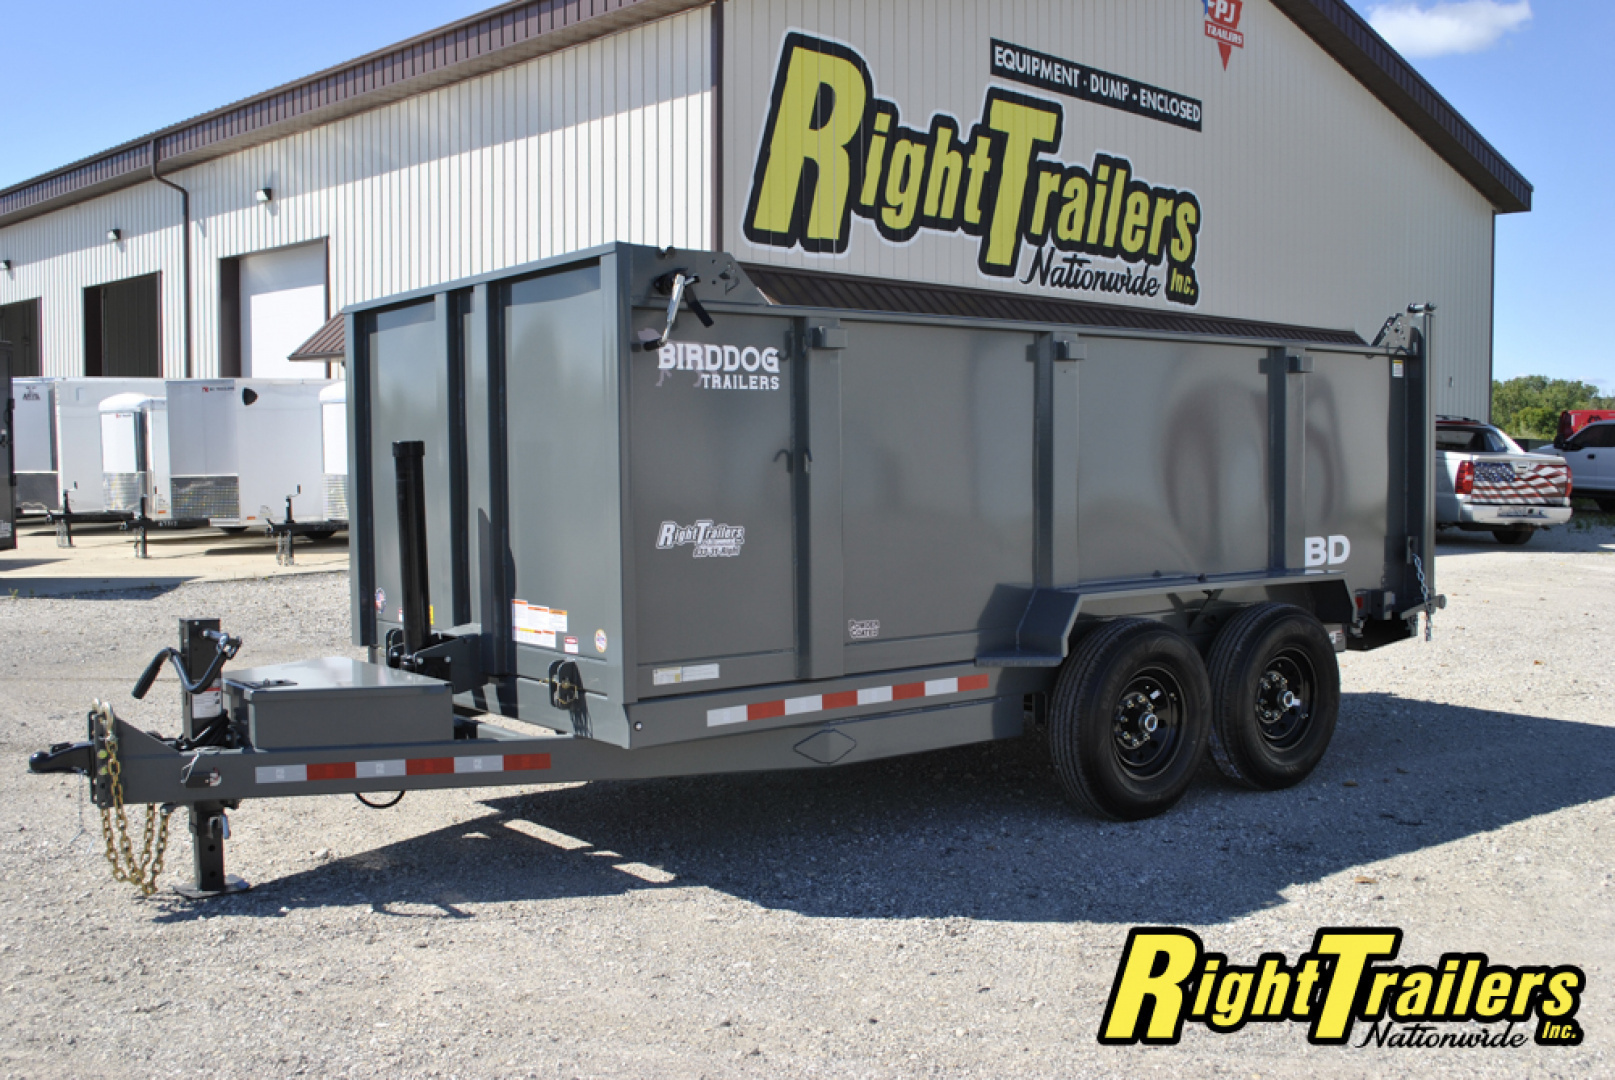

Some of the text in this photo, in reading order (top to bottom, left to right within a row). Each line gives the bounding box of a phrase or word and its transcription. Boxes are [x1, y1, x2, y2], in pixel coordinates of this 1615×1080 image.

[1215, 0, 1235, 22] PJ
[994, 45, 1201, 122] EQUIPMENT DUMP ENCLOSED
[1020, 247, 1195, 297] Nationwide Inc.
[658, 342, 780, 373] BIRDDOG
[701, 374, 780, 390] TRAILERS
[1305, 534, 1351, 567] BD
